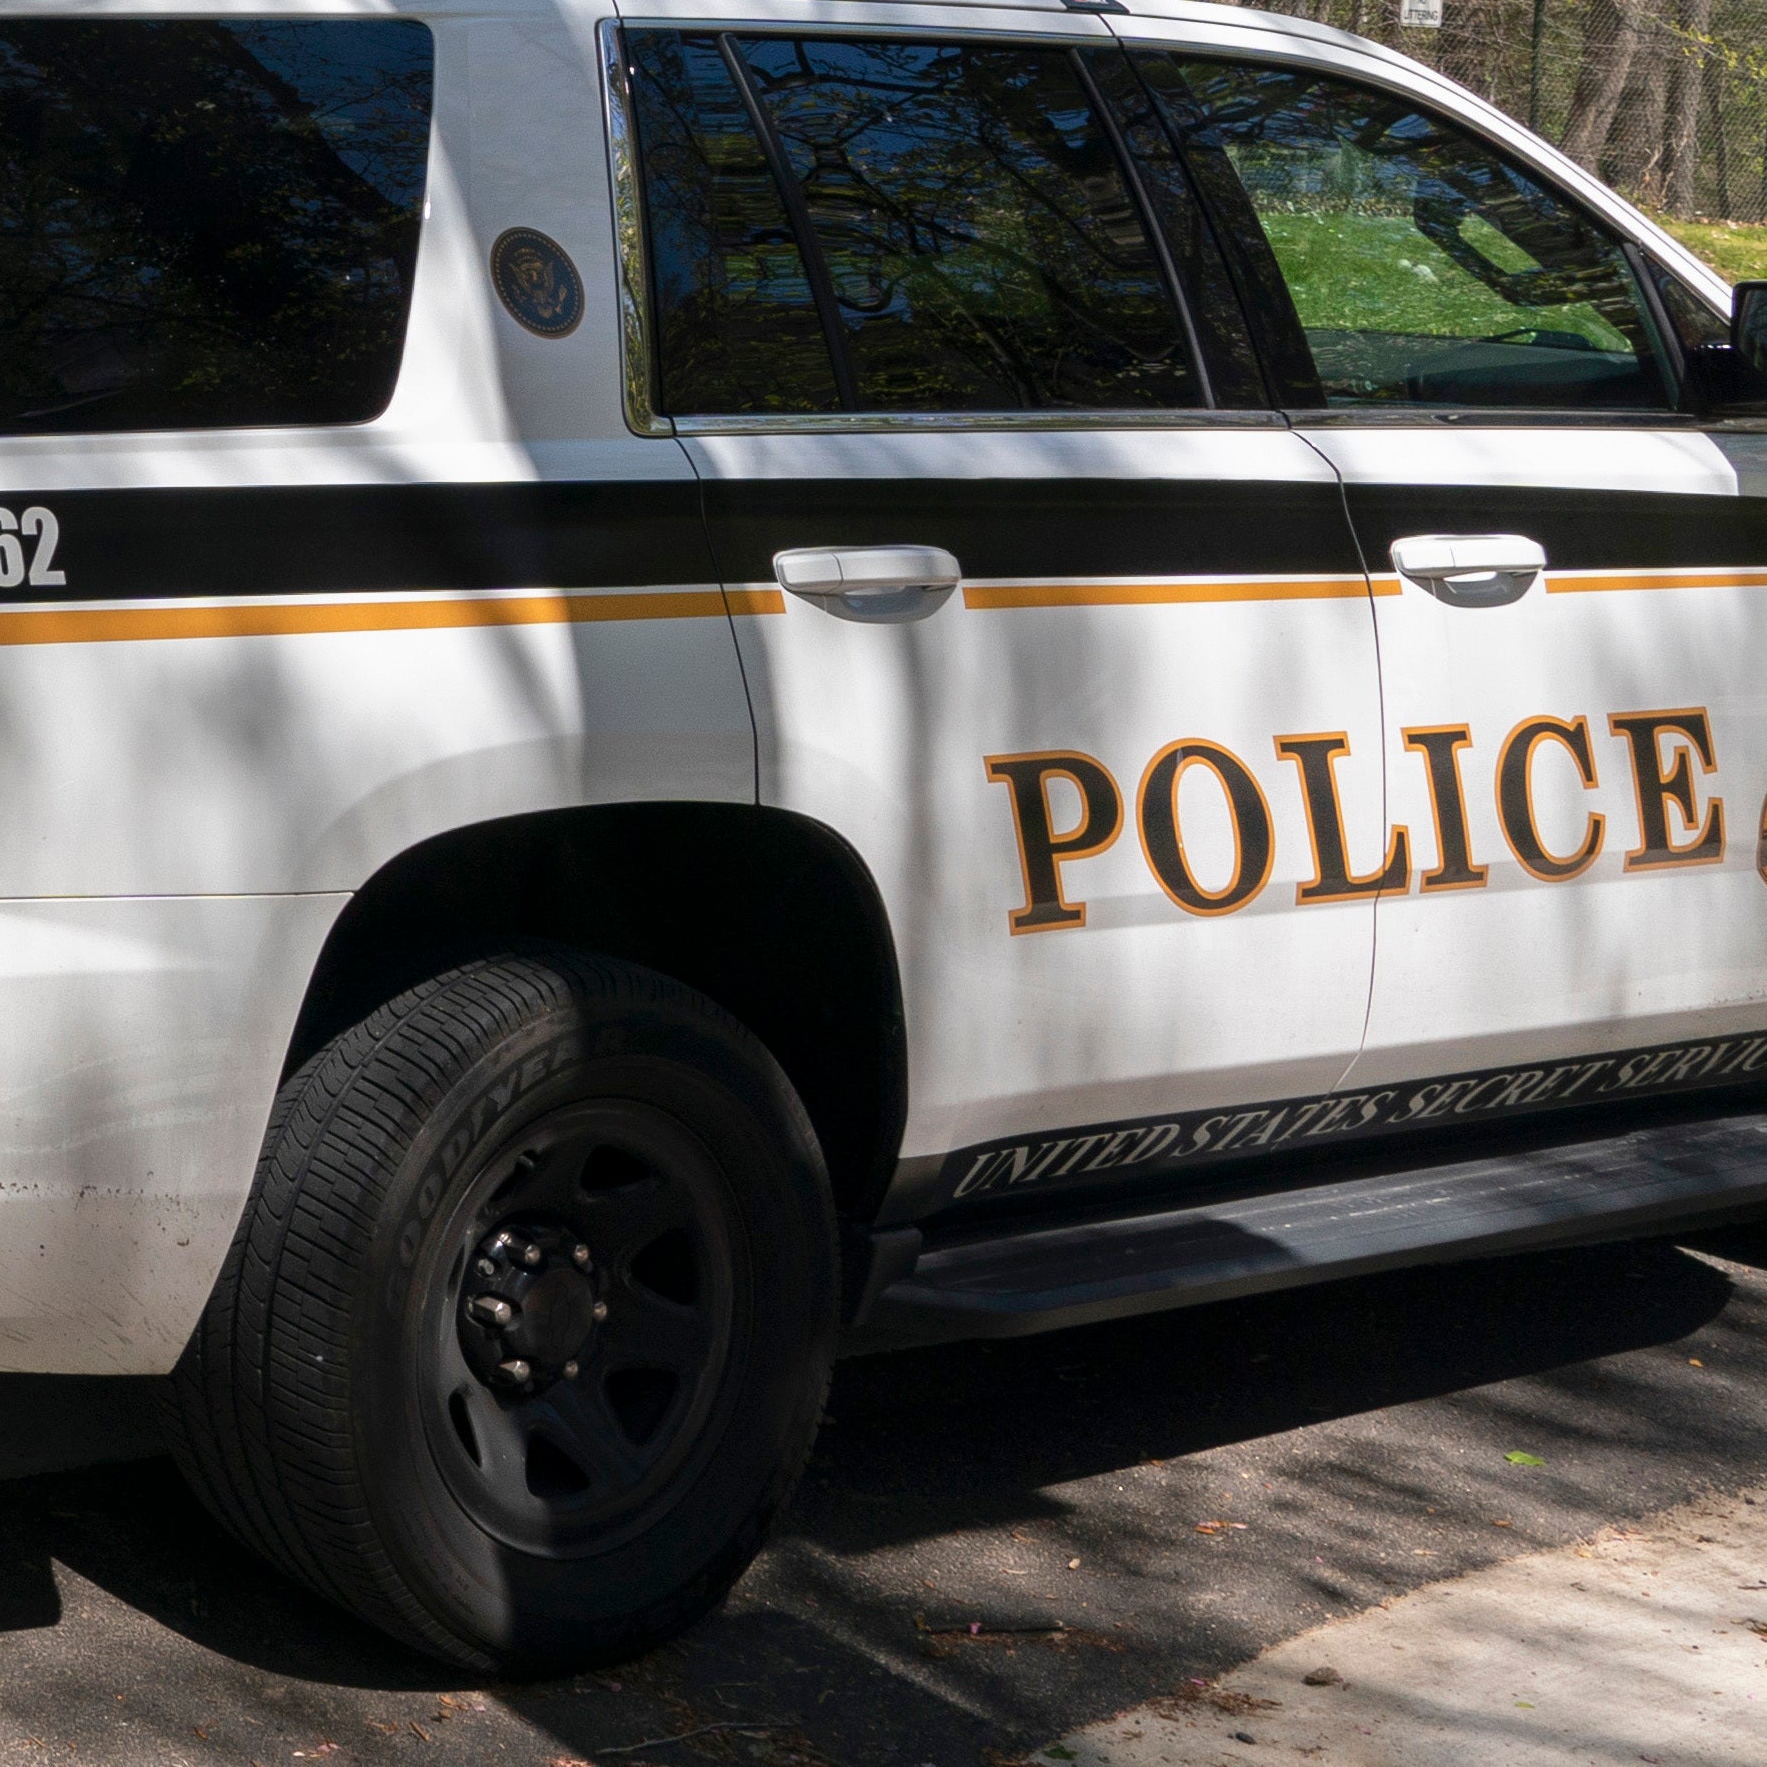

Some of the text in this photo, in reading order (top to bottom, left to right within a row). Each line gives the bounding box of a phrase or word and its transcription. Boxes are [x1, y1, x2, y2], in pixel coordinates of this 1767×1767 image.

[983, 705, 1727, 936] POLICE
[953, 1123, 1180, 1199] UNITED
[1168, 1091, 1396, 1158] STATES
[1388, 1060, 1614, 1123] SECRET
